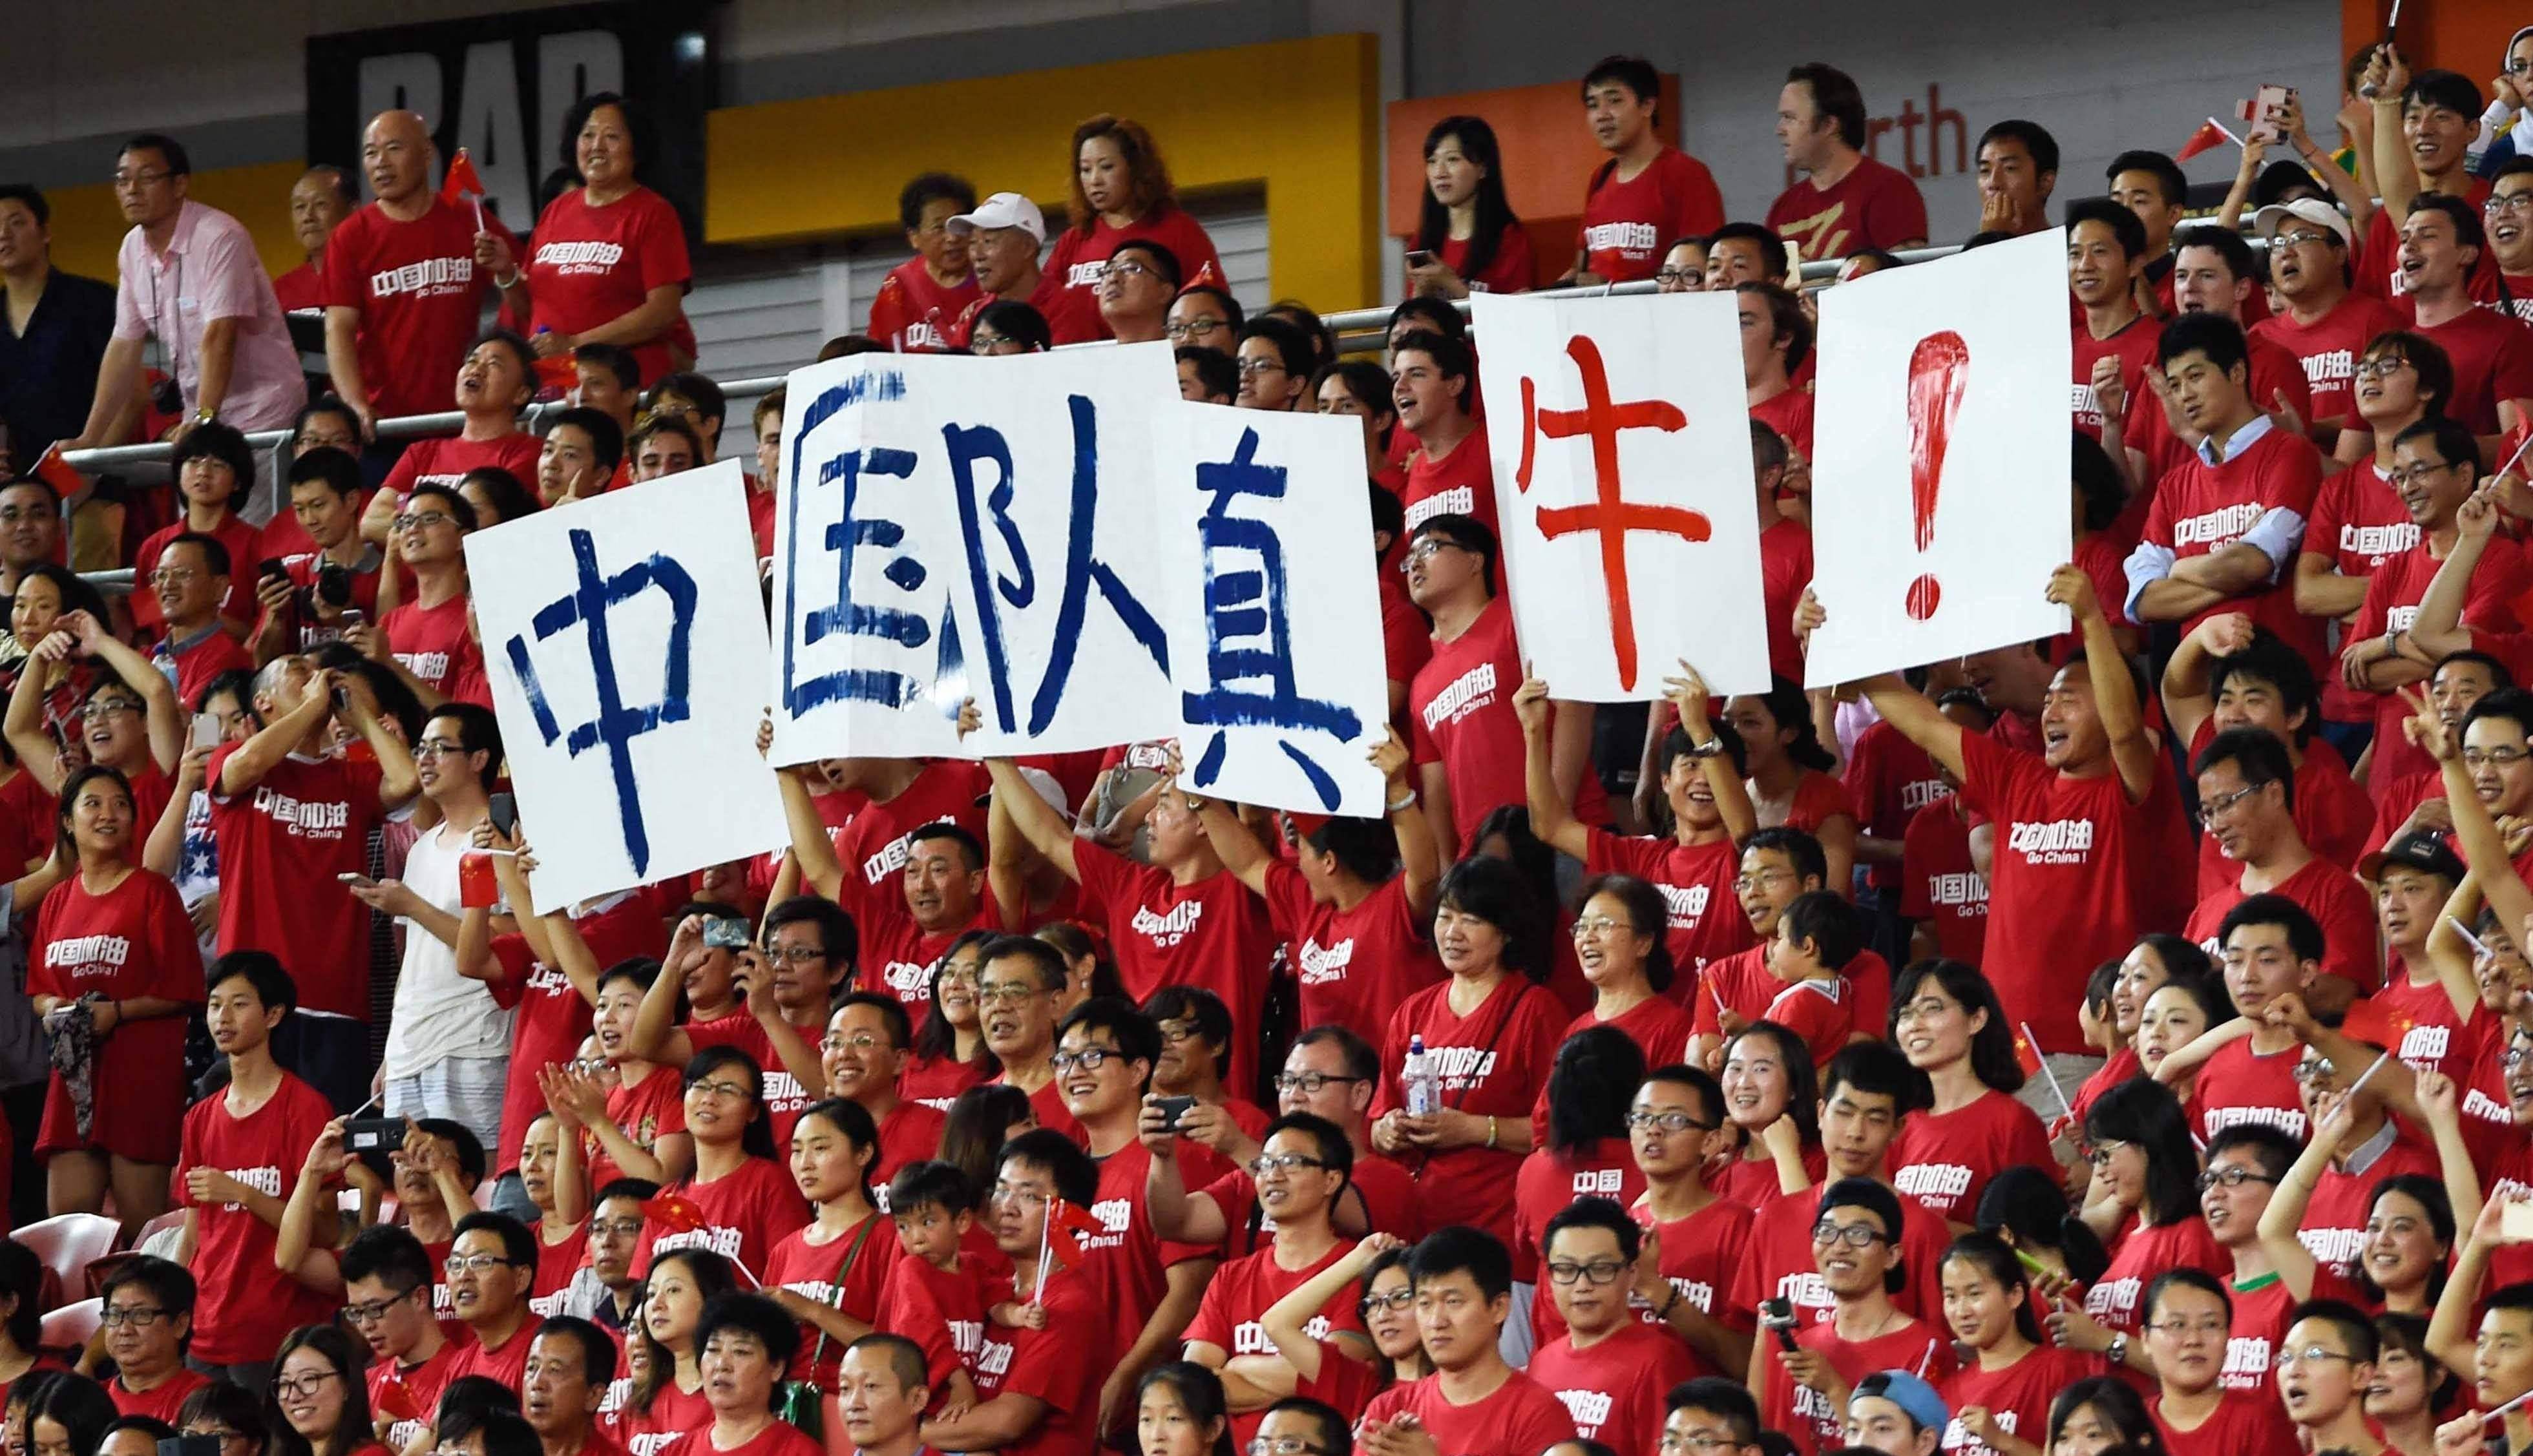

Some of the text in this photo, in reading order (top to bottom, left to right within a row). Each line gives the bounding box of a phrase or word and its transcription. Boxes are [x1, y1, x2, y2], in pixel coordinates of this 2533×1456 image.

[535, 241, 623, 265] 中国加油
[558, 264, 574, 275] Go
[373, 257, 472, 297] 中国加油
[1516, 335, 1712, 692] 牛
[782, 369, 1171, 738] 国队
[2340, 522, 2422, 556] 中国加油
[1182, 424, 1363, 812] 真
[506, 528, 698, 879] 中
[1423, 662, 1497, 732] 中国加油
[253, 786, 350, 829] 中国加油
[2008, 818, 2093, 853] 中国加油
[2026, 851, 2043, 864] Go
[1957, 904, 1973, 918] Go
[45, 934, 130, 968] 中国加油
[72, 965, 87, 978] Go
[770, 1100, 788, 1113] Go
[224, 1165, 282, 1197] 加油
[1573, 1169, 1623, 1194] 中国
